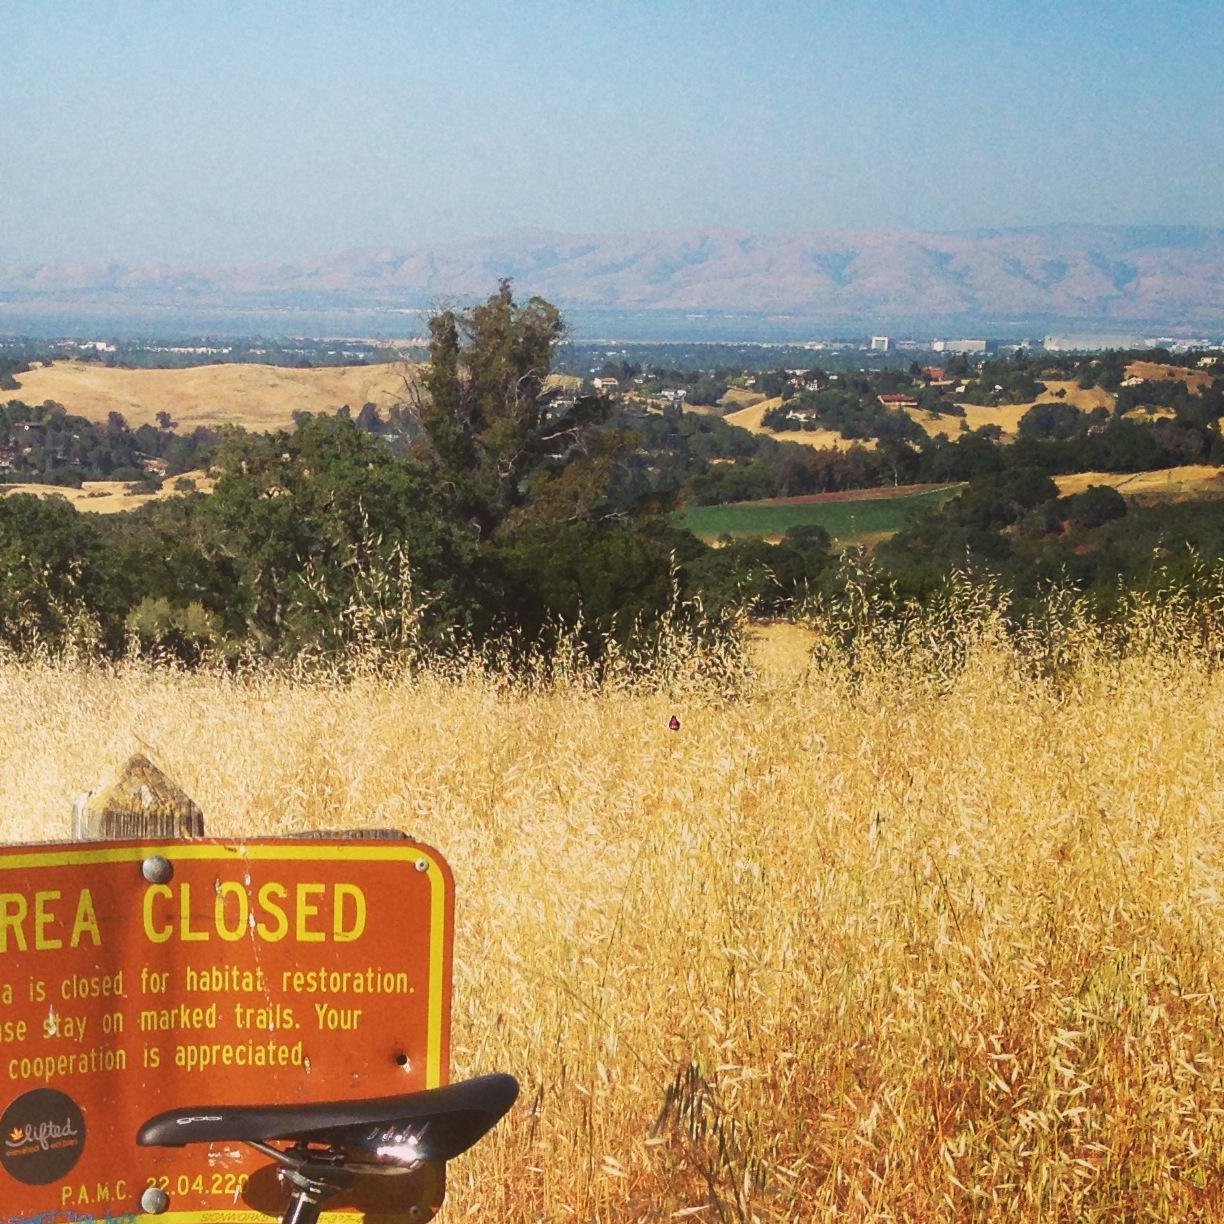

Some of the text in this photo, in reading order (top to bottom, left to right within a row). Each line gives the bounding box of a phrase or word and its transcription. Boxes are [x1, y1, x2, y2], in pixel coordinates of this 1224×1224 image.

[142, 879, 368, 943] CLOSED
[29, 979, 46, 1003] is
[61, 970, 123, 998] closed
[141, 966, 169, 994] for
[185, 964, 264, 993] habitat
[282, 966, 415, 993] restoration.
[42, 1011, 86, 1042] stay
[102, 1014, 124, 1033] on
[141, 1002, 217, 1031] marked
[234, 1002, 301, 1031] trails.
[314, 1003, 362, 1031] Your
[8, 1042, 311, 1081] cooperation is appreciated.
[5, 1117, 78, 1150] lifted
[62, 1179, 132, 1206] P.A.M.C.
